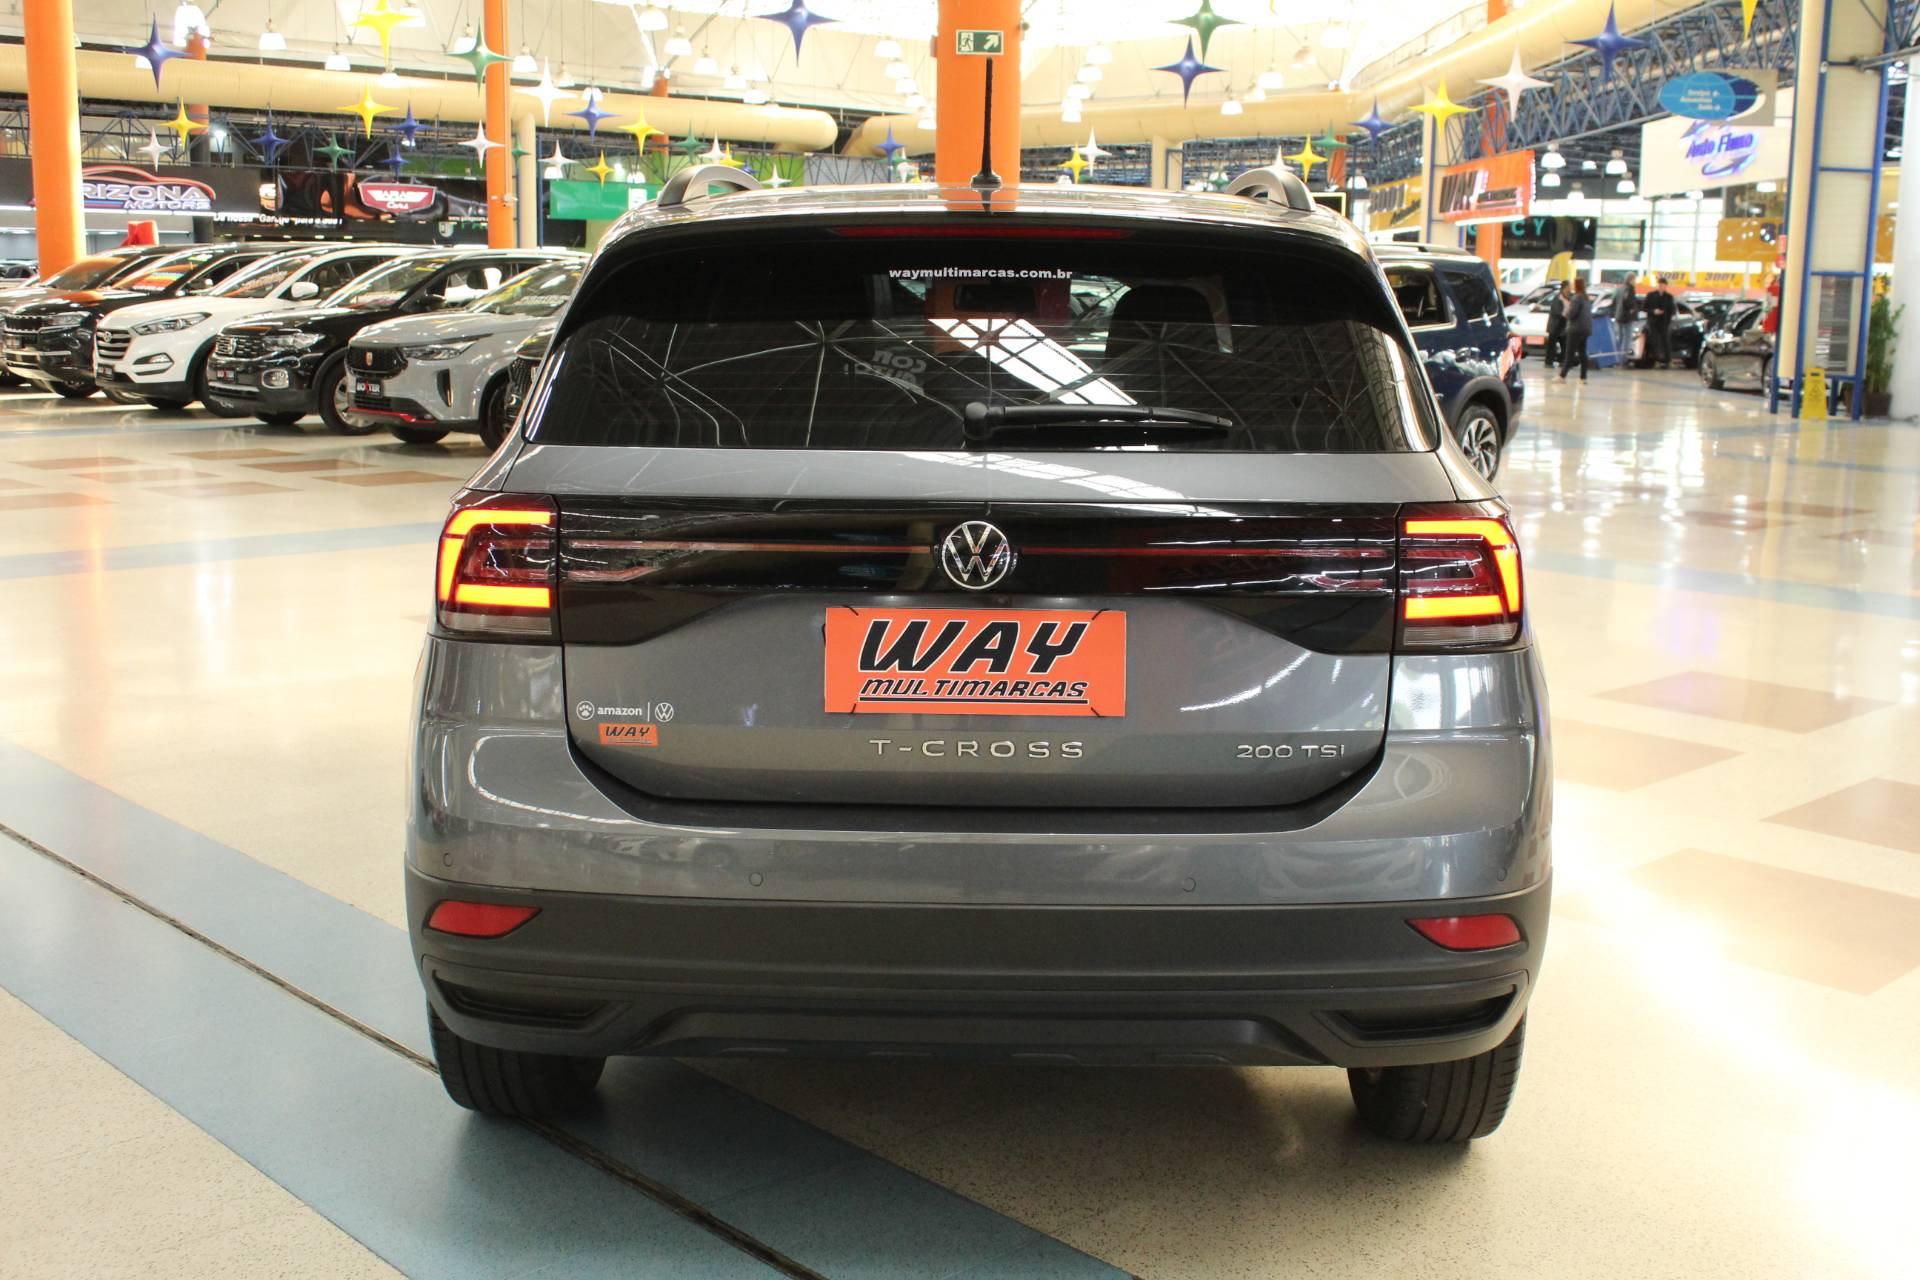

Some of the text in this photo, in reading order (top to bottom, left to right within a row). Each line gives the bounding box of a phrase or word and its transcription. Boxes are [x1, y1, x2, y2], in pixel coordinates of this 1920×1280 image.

[83, 183, 209, 202] RIZONA
[123, 199, 211, 210] MOTORS
[889, 267, 1072, 279] waymultimarcas.com.br
[858, 618, 1091, 675] WAY
[859, 678, 1089, 698] MULTIMARCAS
[597, 706, 643, 716] amazon
[605, 725, 651, 737] WAY
[869, 739, 1084, 759] T-CROSS
[1236, 744, 1346, 758] 200 TSI
